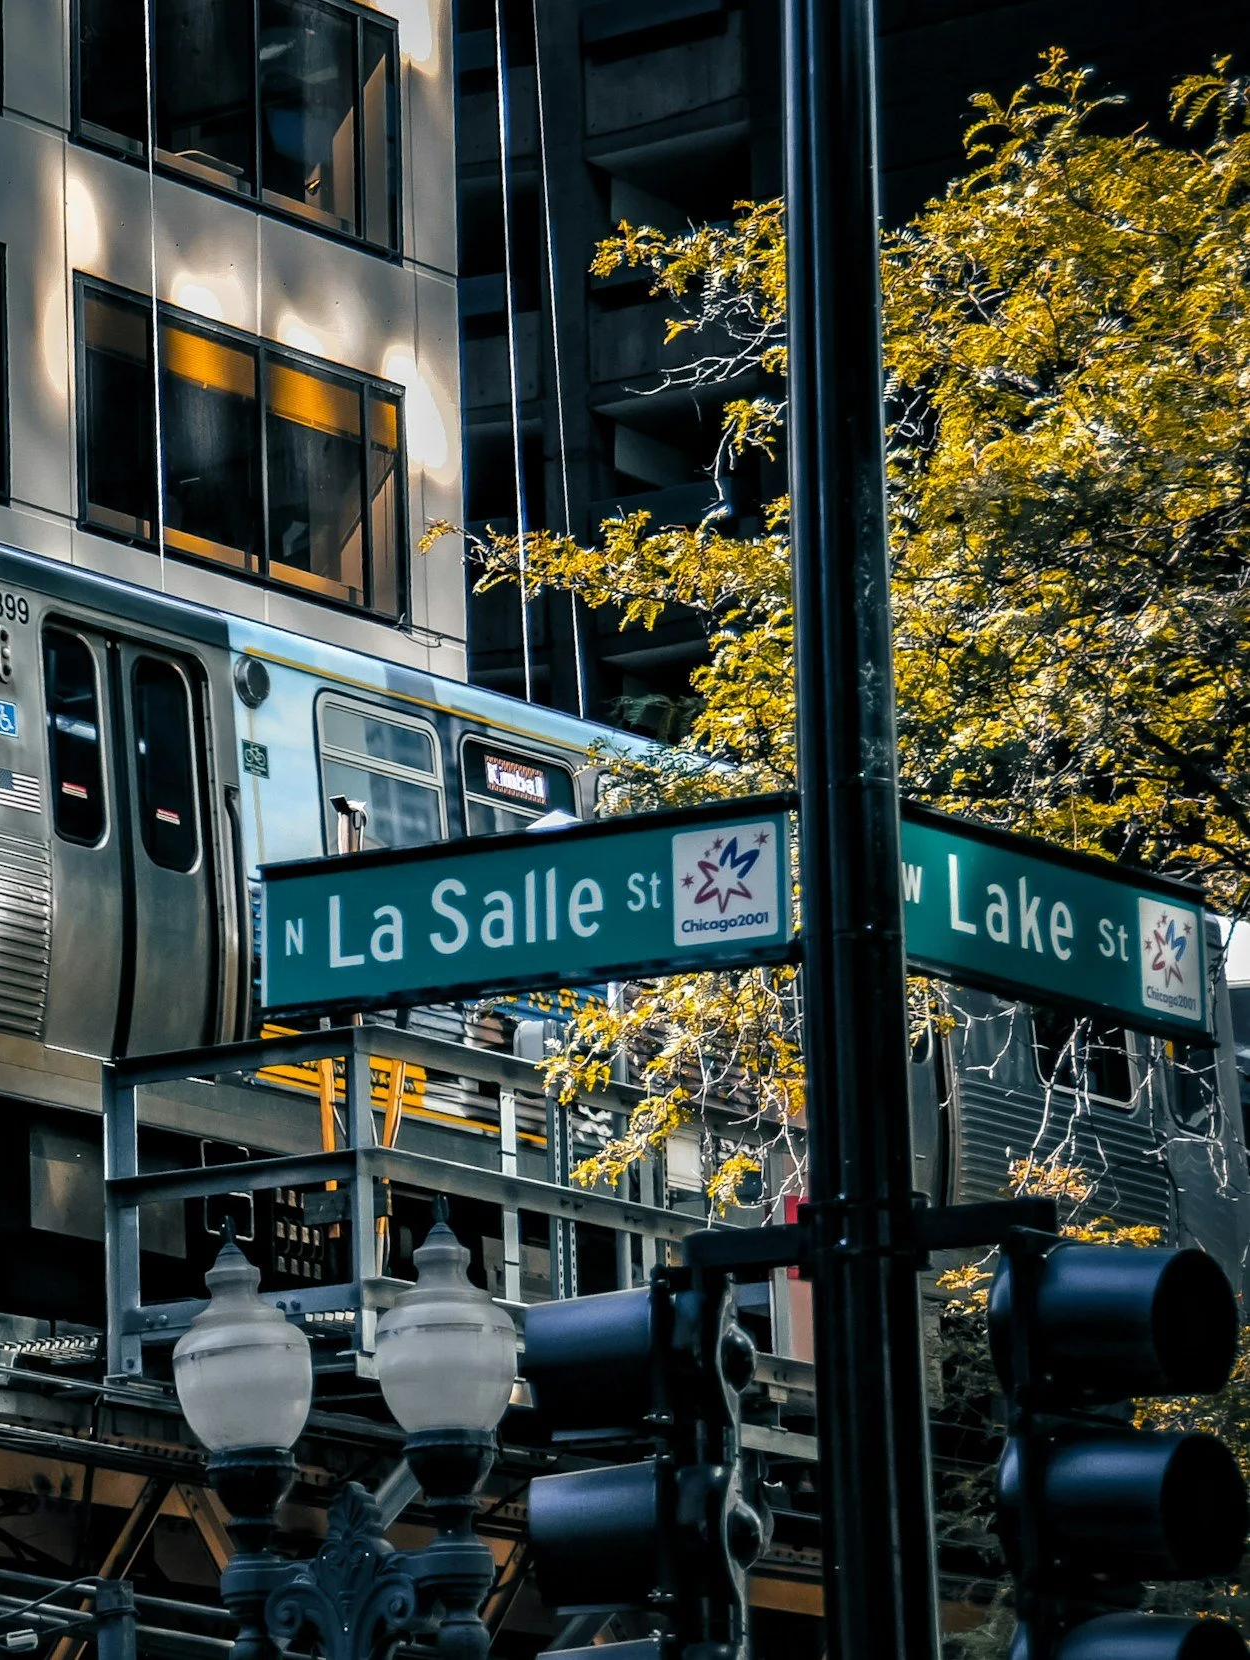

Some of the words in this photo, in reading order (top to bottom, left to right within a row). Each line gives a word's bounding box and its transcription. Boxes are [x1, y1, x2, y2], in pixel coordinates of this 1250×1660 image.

[285, 918, 304, 956] N
[329, 895, 403, 968] La
[430, 867, 604, 954] Salle
[627, 872, 662, 912] St
[681, 912, 769, 933] Chicago2001
[901, 861, 922, 904] W
[948, 853, 1073, 961] Lake
[1099, 918, 1129, 962] St
[1146, 985, 1197, 1011] Chicago2001
